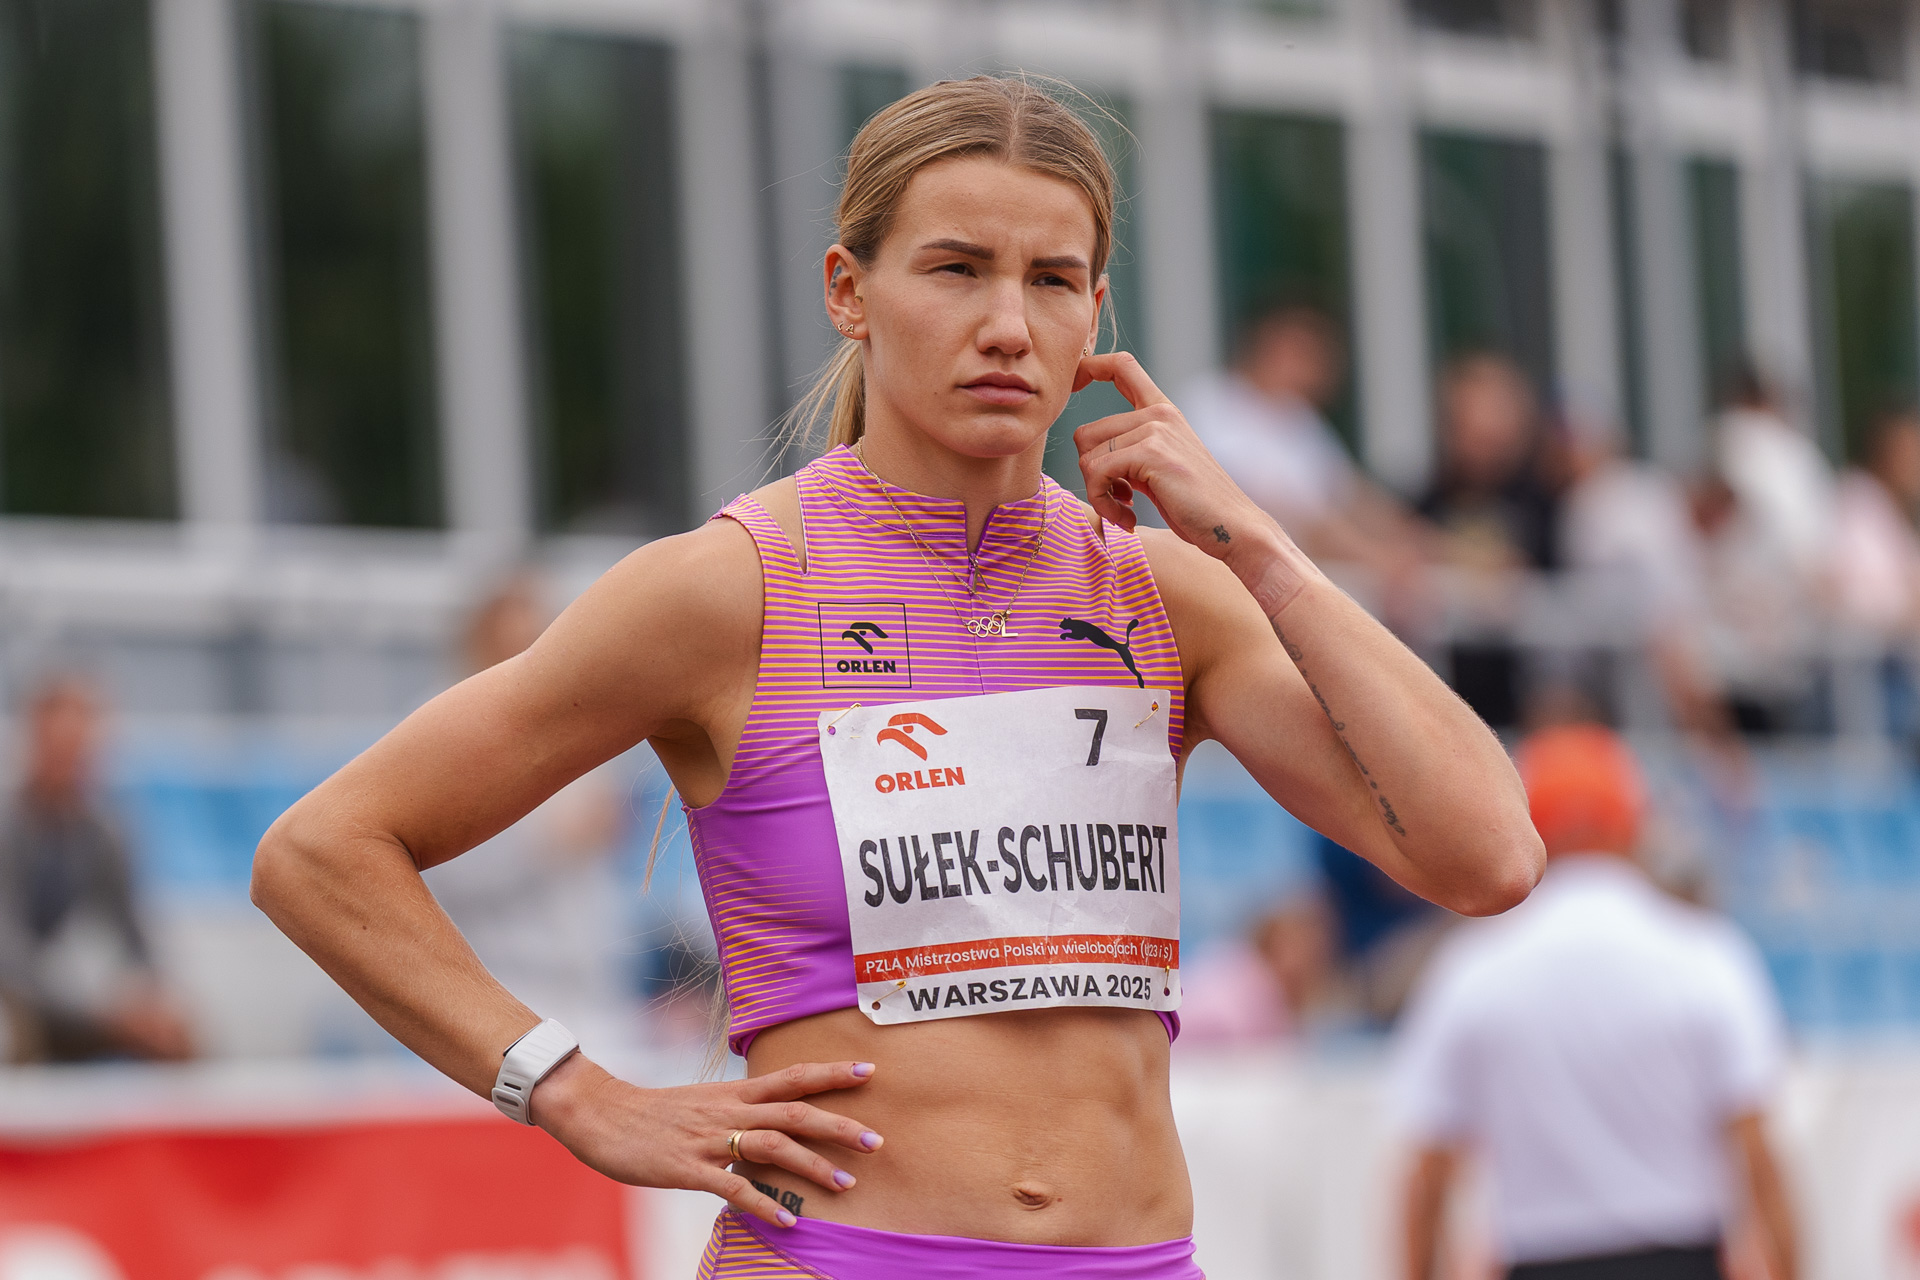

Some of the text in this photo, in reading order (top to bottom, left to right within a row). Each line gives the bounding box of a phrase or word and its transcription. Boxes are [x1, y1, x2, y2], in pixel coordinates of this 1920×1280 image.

[836, 660, 896, 674] ORLEN
[1074, 708, 1108, 767] 7
[875, 766, 965, 794] ORLEN
[859, 823, 1167, 908] SUŁEK-SCHUBERT
[866, 959, 902, 974] PZLA
[905, 946, 1000, 969] Mistrzostwa
[1003, 944, 1046, 958] Polski
[1047, 945, 1059, 955] w
[1062, 940, 1138, 958] wielobojach
[907, 974, 1151, 1012] WARSZAWA 2025
